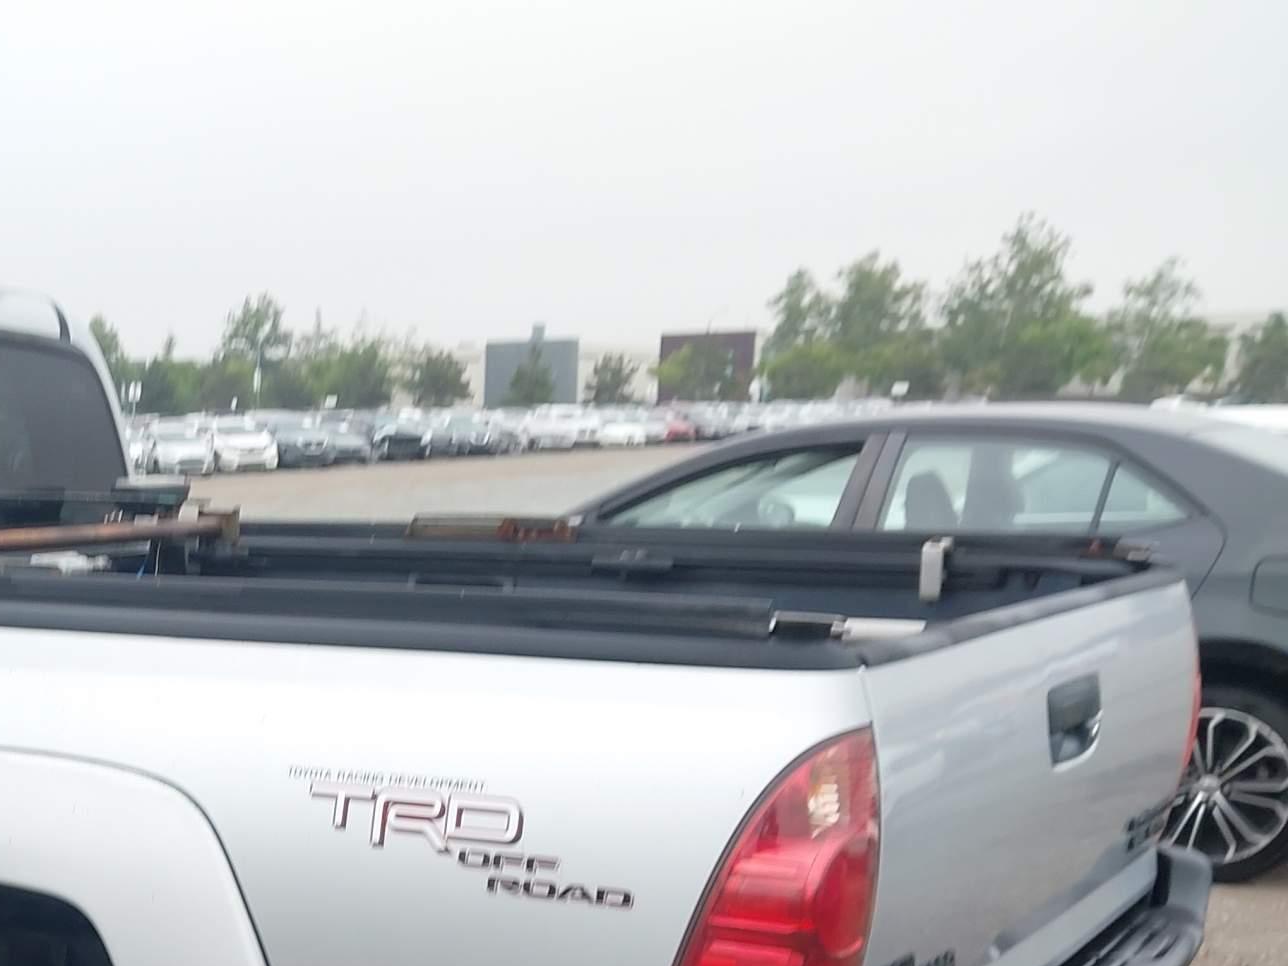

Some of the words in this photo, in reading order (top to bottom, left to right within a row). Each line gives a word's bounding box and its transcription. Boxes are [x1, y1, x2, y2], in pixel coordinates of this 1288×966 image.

[337, 769, 384, 785] RACING
[388, 772, 486, 793] DEVELOPMENT
[310, 782, 525, 856] TRD
[457, 848, 562, 874] OFF
[486, 875, 634, 910] ROAD
